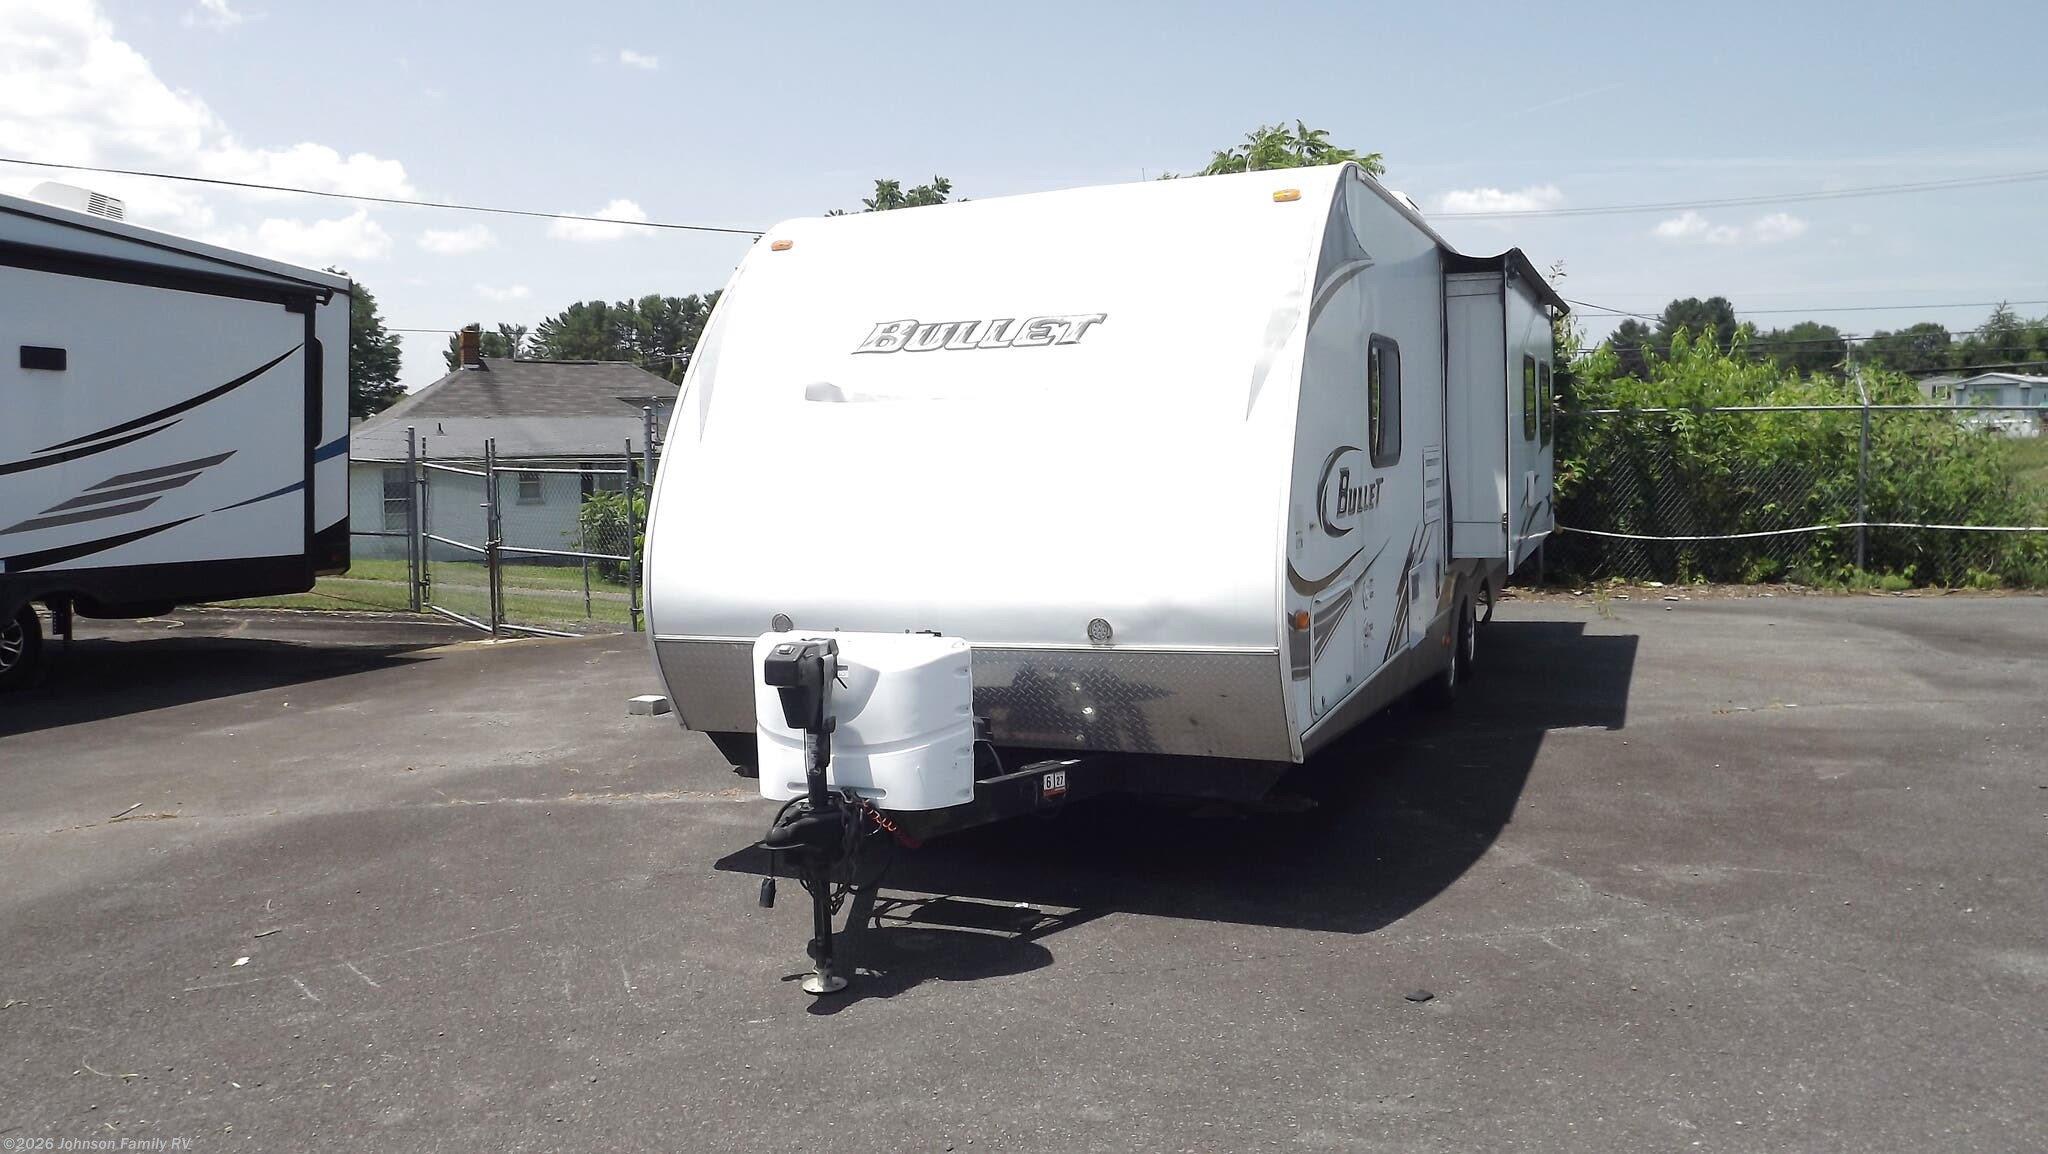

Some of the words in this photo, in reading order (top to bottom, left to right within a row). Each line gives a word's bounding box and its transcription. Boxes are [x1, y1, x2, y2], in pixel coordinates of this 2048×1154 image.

[851, 313, 1107, 355] BULLET
[1337, 467, 1384, 518] BULLET
[1046, 775, 1052, 788] 6
[1056, 775, 1064, 786] 27
